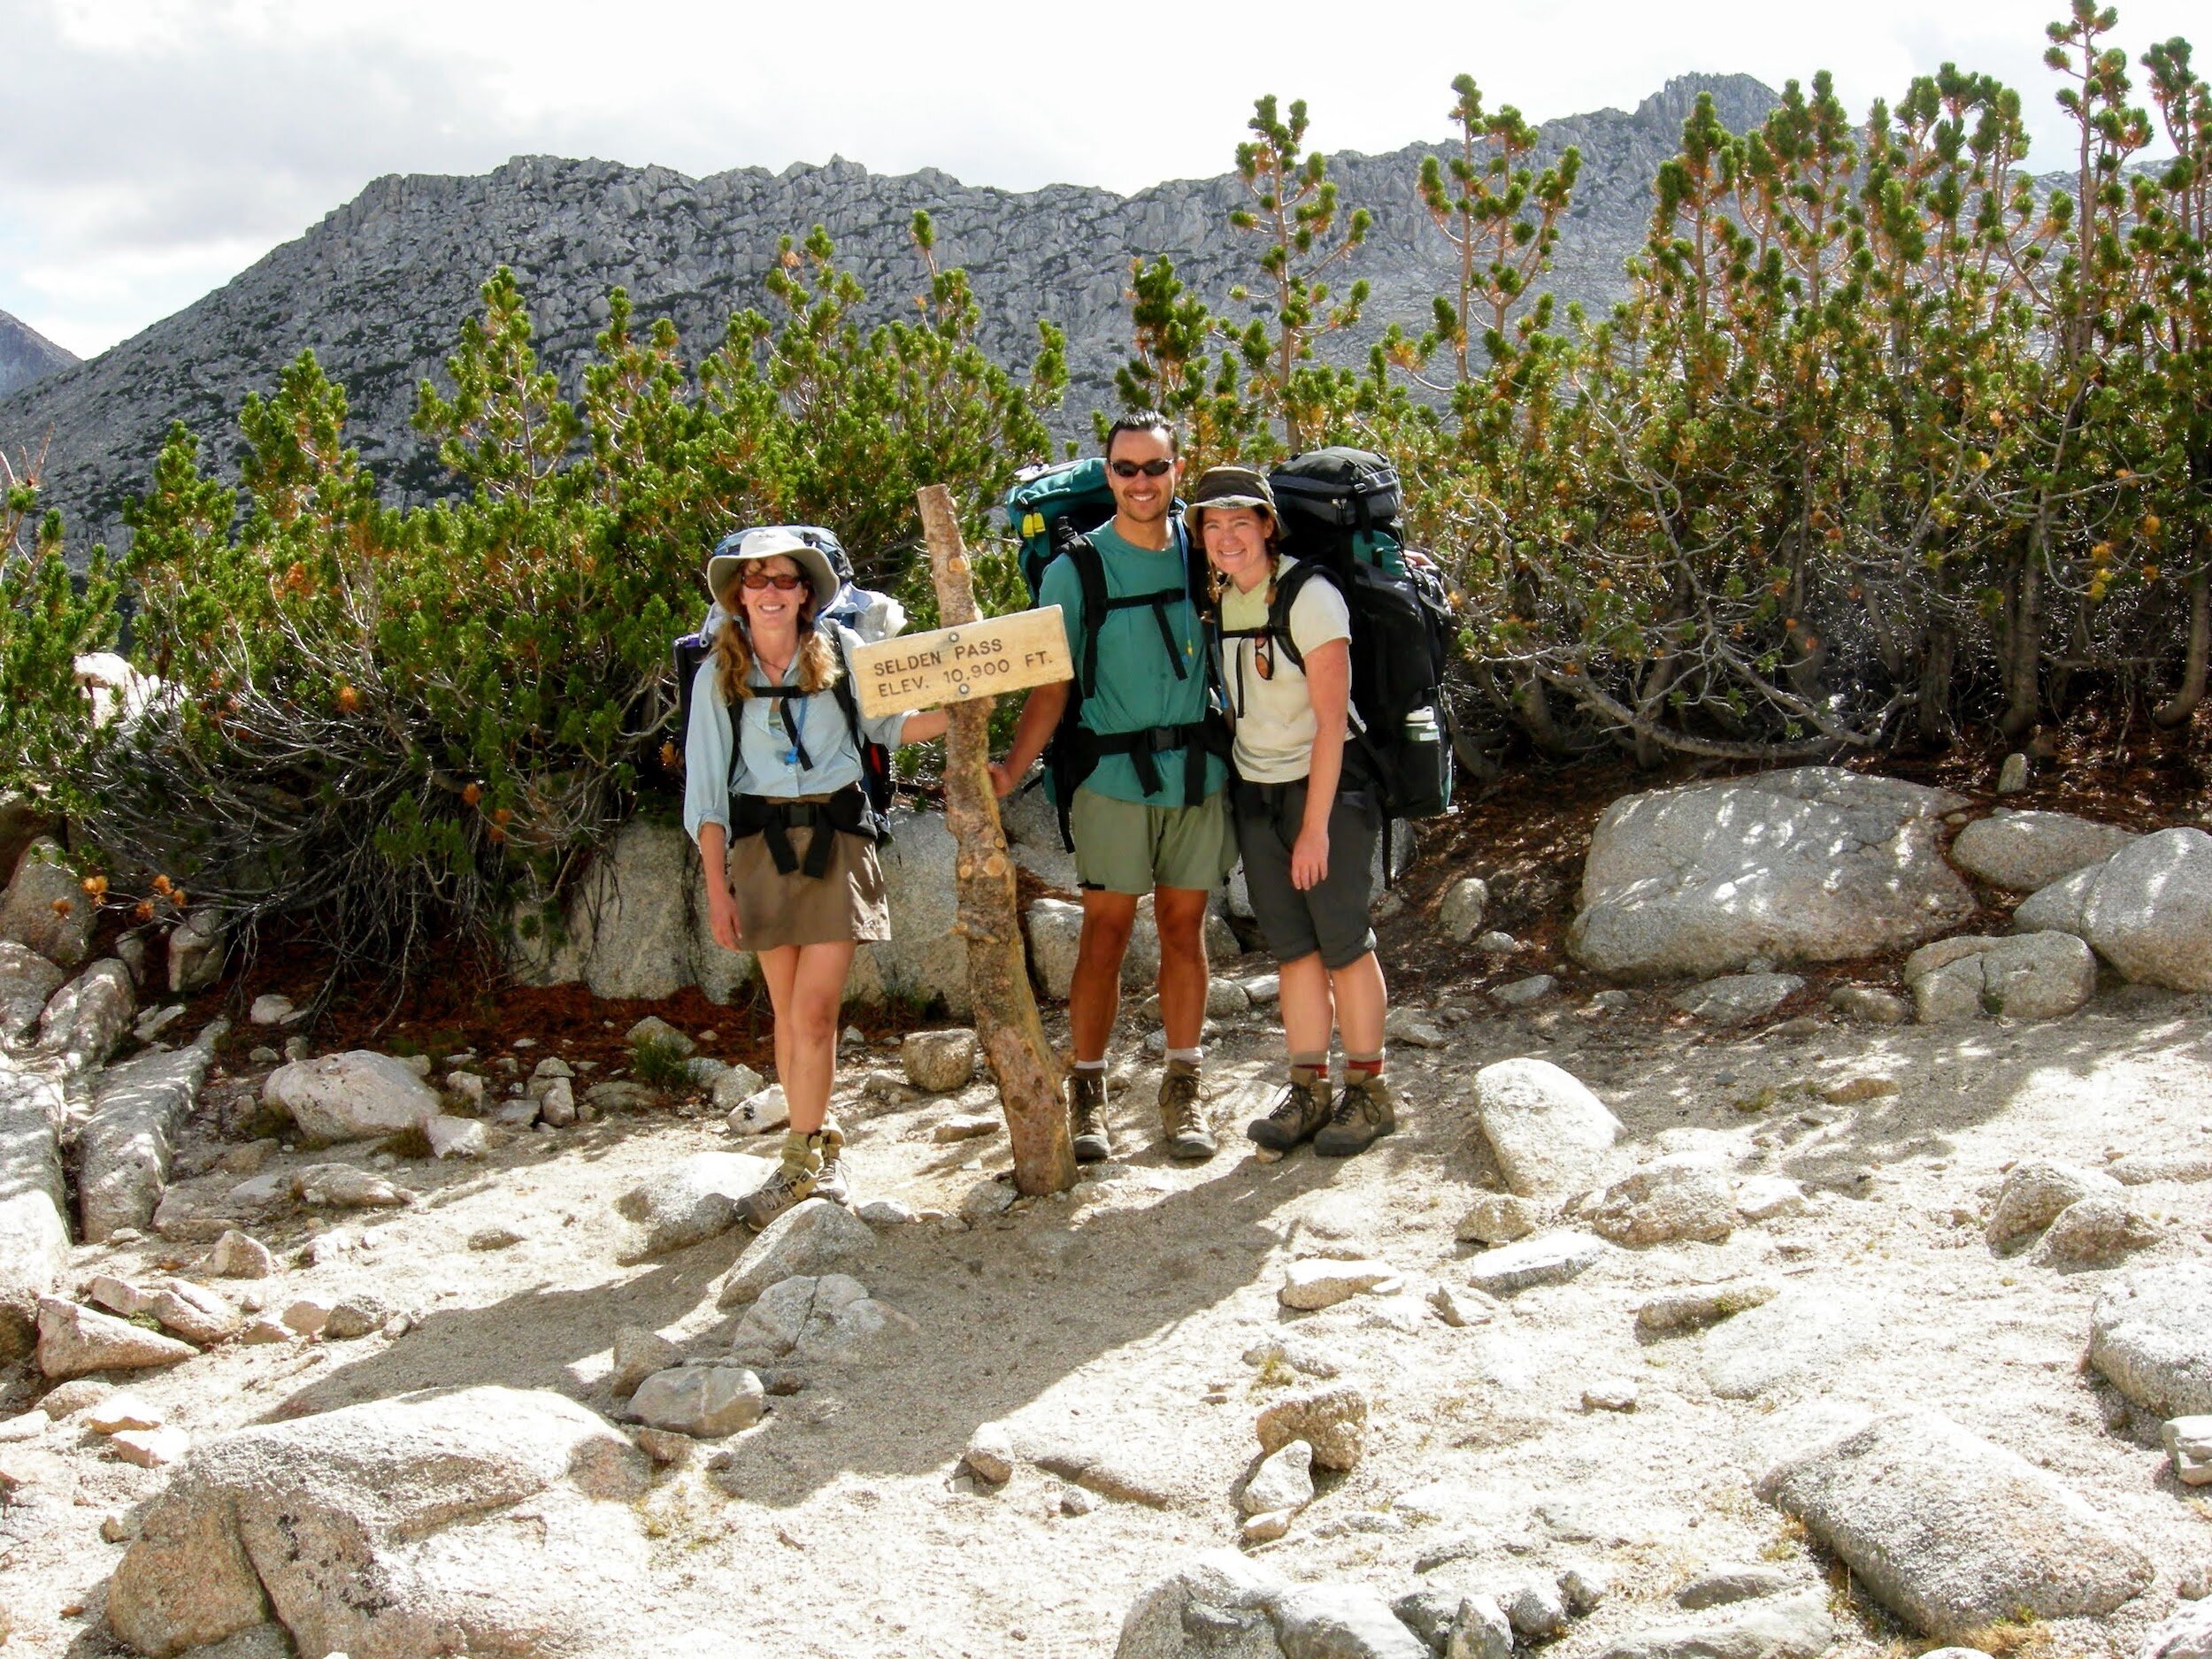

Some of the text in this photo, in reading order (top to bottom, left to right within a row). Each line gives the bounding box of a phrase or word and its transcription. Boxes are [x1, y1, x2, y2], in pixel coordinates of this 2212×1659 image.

[874, 639, 1002, 676] SELDEN PASS
[878, 676, 929, 697] ELEV.
[1025, 650, 1053, 667] FT.
